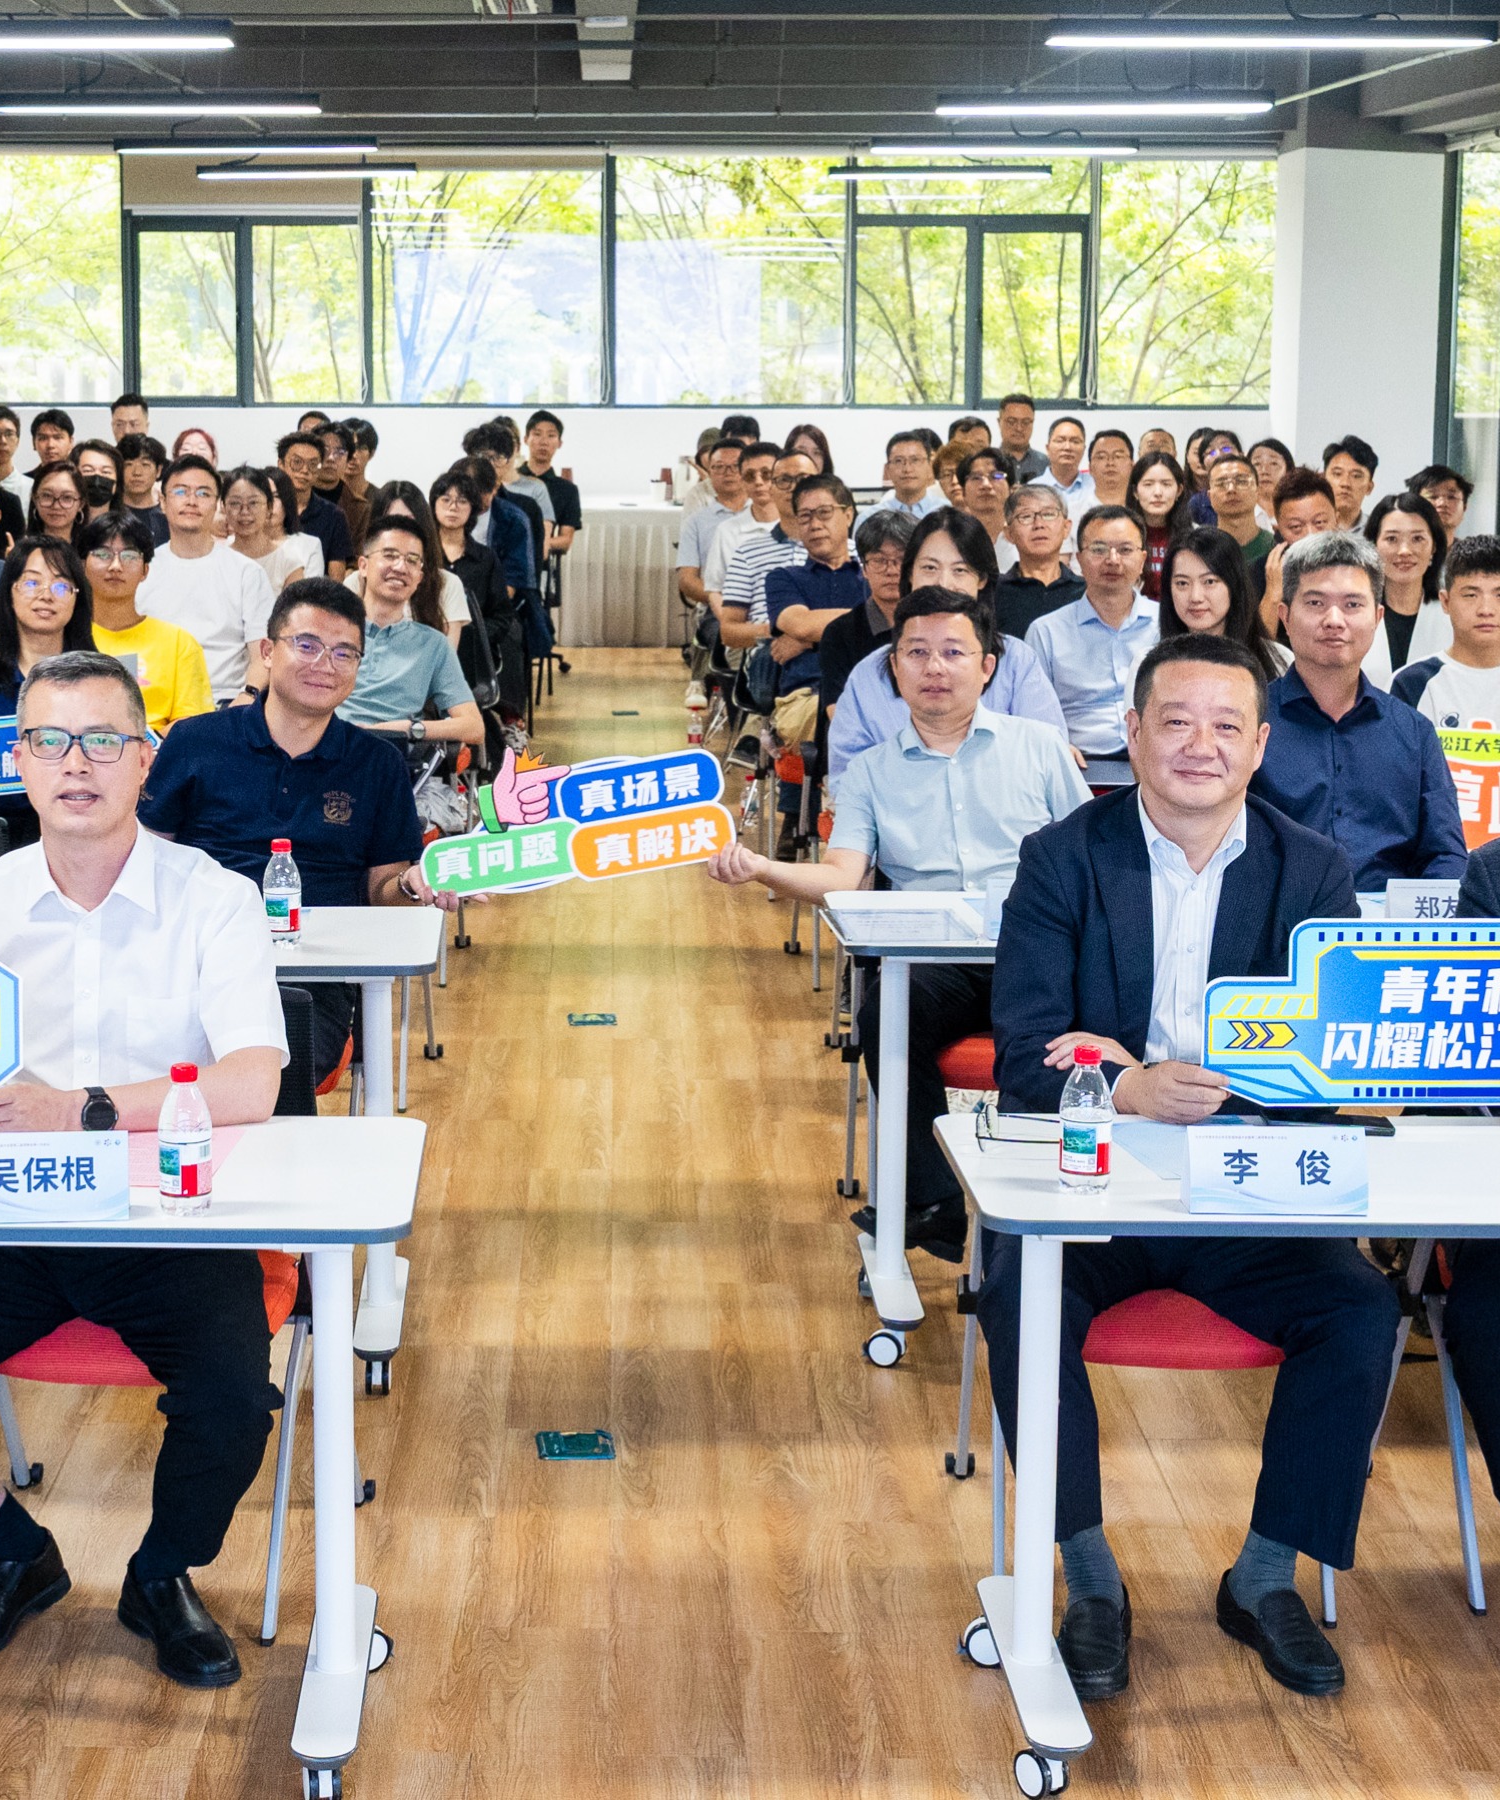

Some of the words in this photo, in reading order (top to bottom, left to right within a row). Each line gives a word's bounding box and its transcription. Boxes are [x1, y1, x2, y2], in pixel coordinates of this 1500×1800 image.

[578, 763, 701, 817] 真场景
[435, 830, 560, 884] 真问题
[594, 817, 718, 871] 真解决
[1223, 1149, 1259, 1185] 李
[1295, 1149, 1331, 1186] 俊
